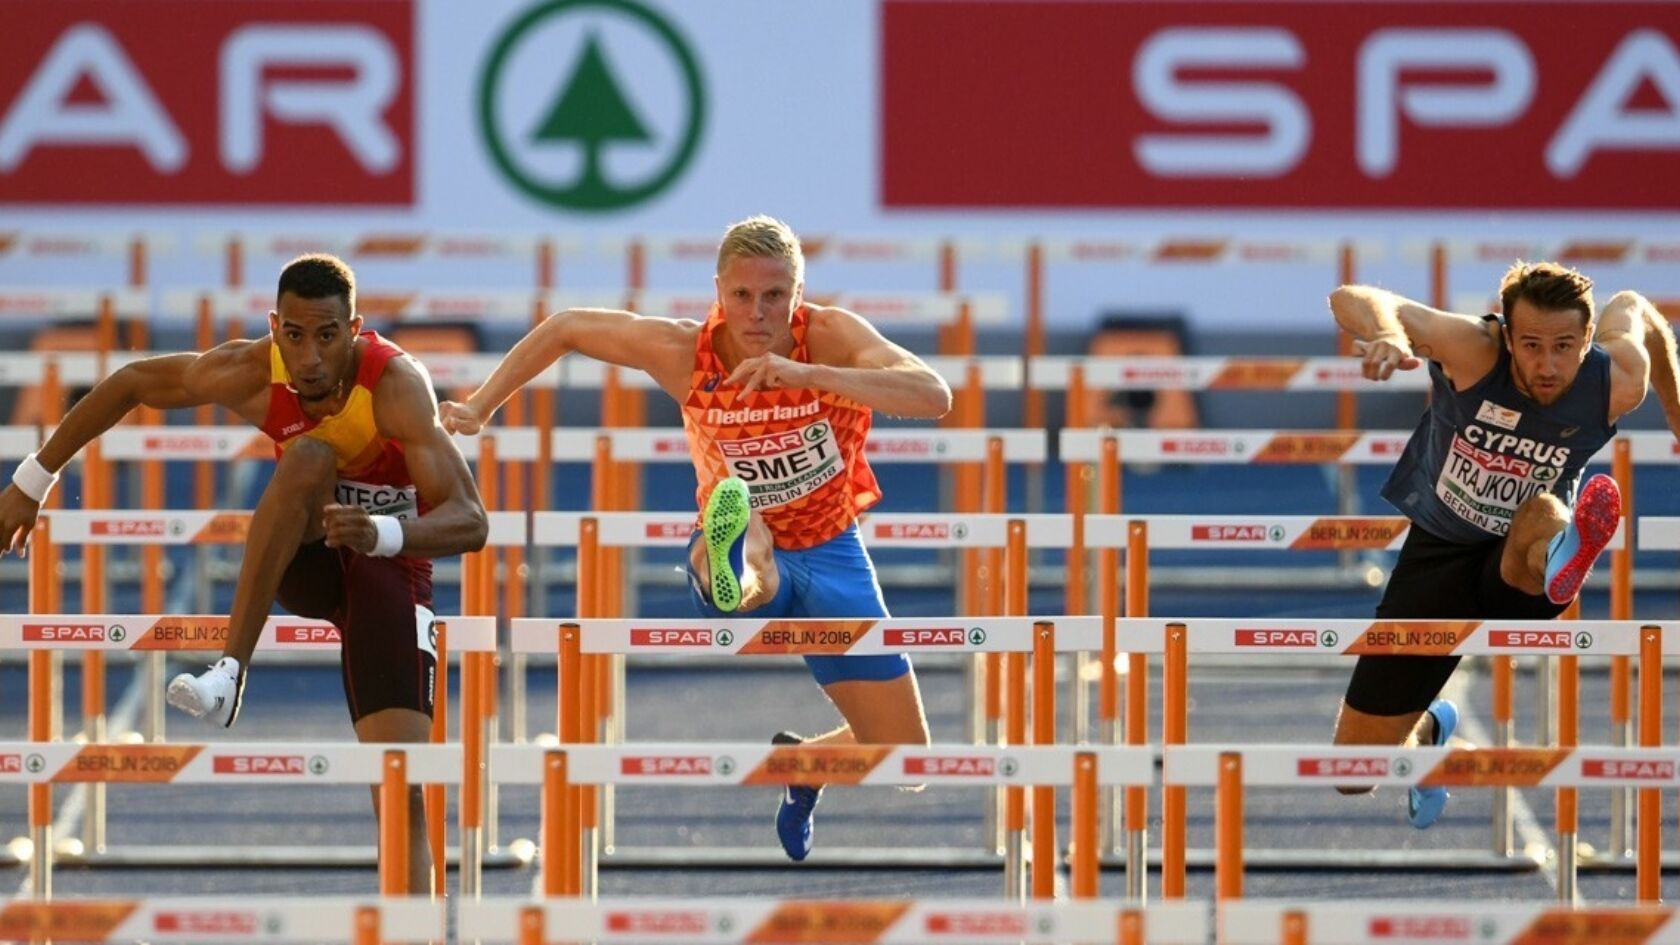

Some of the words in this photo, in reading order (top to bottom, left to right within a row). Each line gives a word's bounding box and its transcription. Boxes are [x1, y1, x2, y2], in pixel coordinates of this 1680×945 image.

[707, 400, 820, 425] Nederland
[723, 433, 801, 456] SPAR
[1464, 425, 1570, 467] CYPRUS
[734, 439, 828, 482] SMET
[1454, 440, 1530, 475] SPAR
[750, 489, 802, 508] BERLIN
[806, 465, 836, 491] 2018
[1444, 490, 1488, 528] BERLIN
[106, 521, 164, 535] SPAR
[891, 524, 948, 537] SPAR
[1208, 526, 1265, 540] SPAR
[1311, 528, 1359, 540] BERLIN
[1362, 528, 1392, 540] 2018
[41, 627, 104, 639] SPAR
[154, 627, 207, 640] BERLIN
[648, 631, 711, 643] SPAR
[762, 631, 815, 645] BERLIN
[819, 631, 851, 645] 2018
[901, 630, 964, 643] SPAR
[1253, 631, 1316, 644] SPAR
[1367, 632, 1420, 645] BERLIN
[1423, 632, 1457, 645] 2018
[1507, 632, 1570, 645] SPAR
[77, 756, 137, 771] BERLIN
[141, 756, 178, 771] 2018
[233, 757, 303, 772] SPAR
[641, 758, 711, 773] SPAR
[767, 758, 827, 774] BERLIN
[831, 758, 868, 774] 2018
[922, 758, 993, 774] SPAR
[1317, 759, 1387, 774] SPAR
[1444, 759, 1504, 774] BERLIN
[1602, 760, 1673, 776] SPAR
